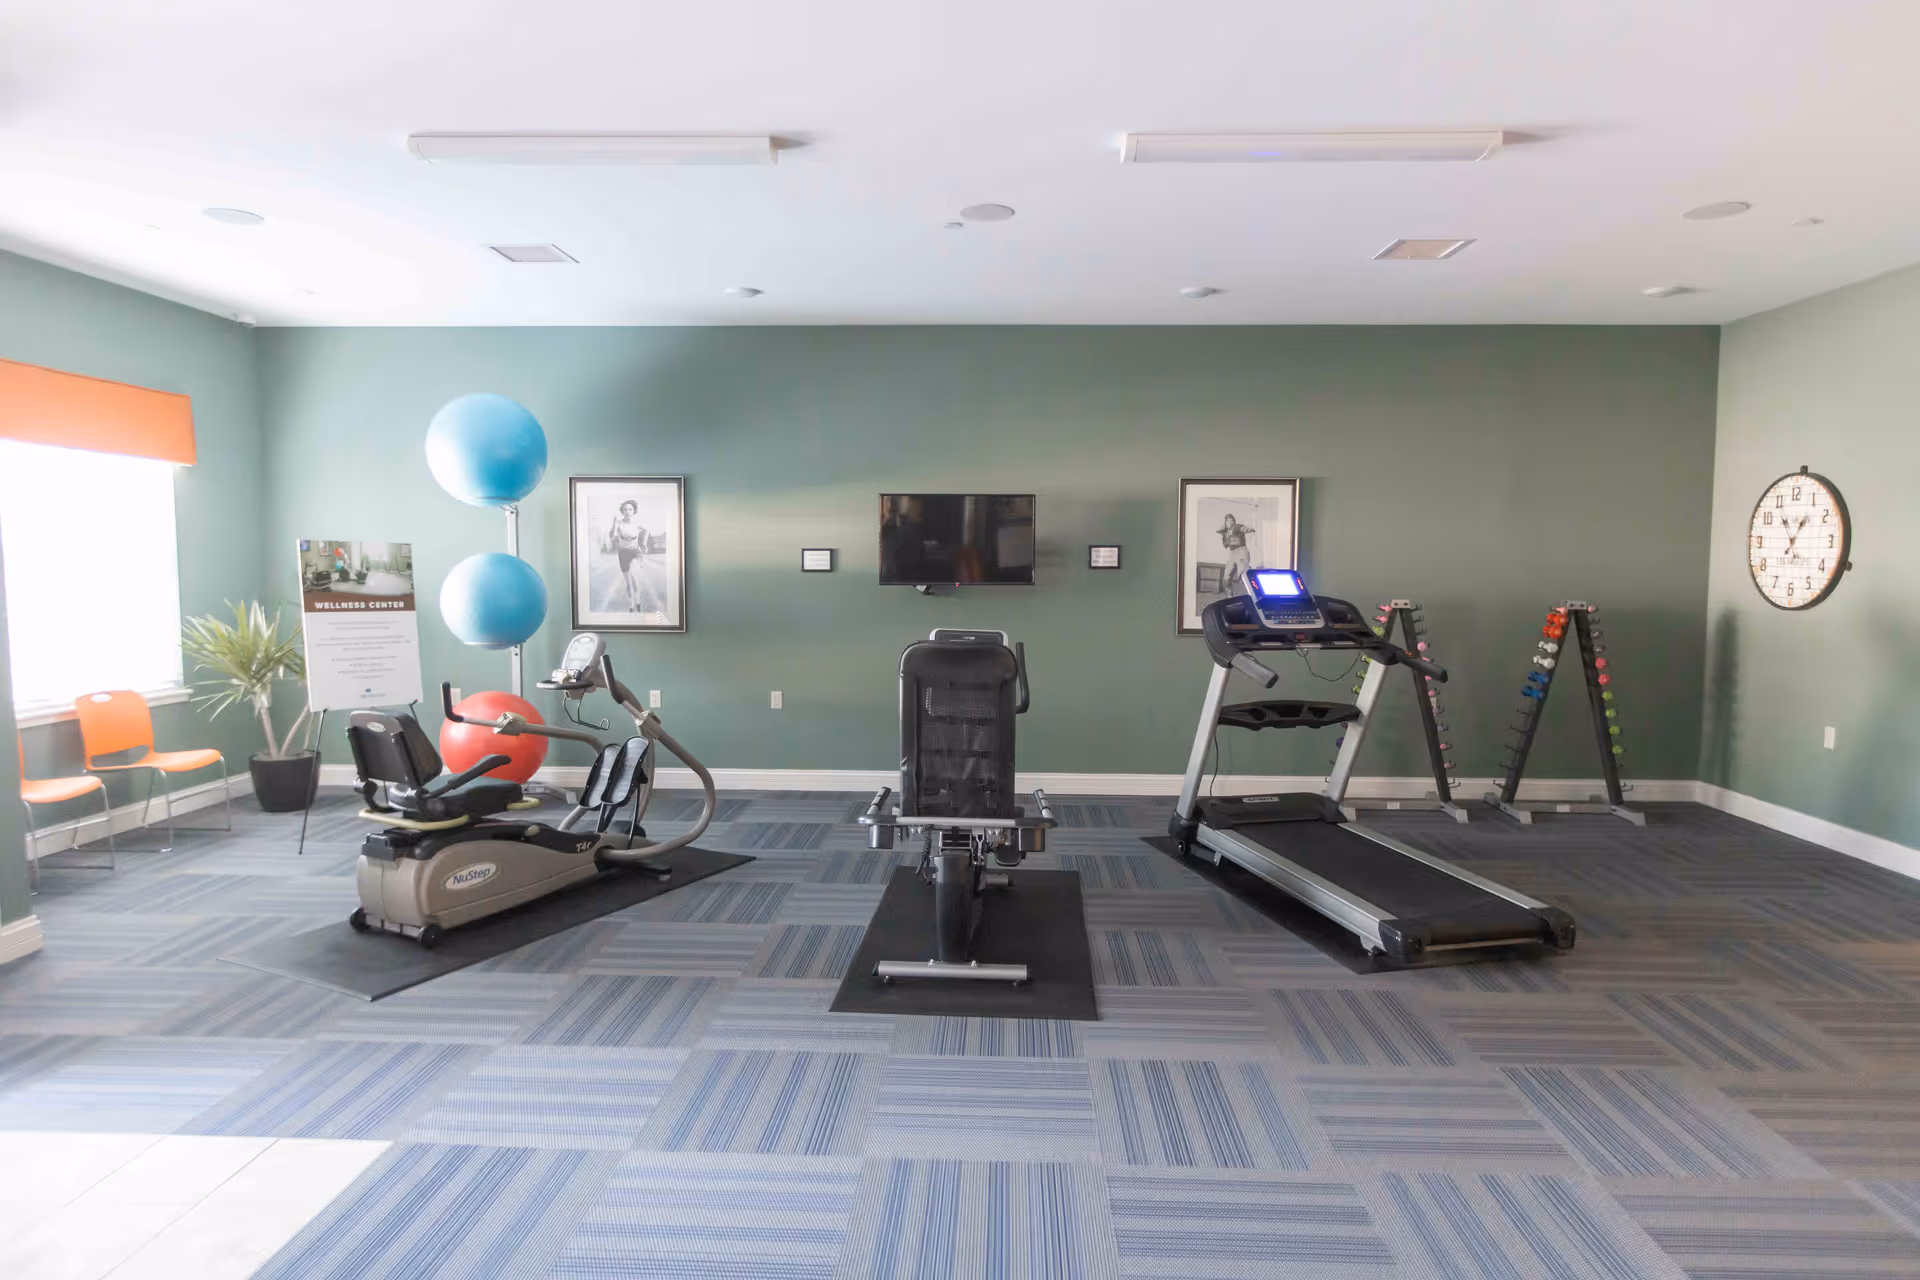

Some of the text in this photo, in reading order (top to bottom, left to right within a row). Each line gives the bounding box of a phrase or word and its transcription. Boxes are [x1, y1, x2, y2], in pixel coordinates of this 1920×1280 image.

[1792, 487, 1801, 501] 12
[1776, 495, 1783, 509] 11
[1763, 511, 1773, 525] 10
[1823, 509, 1829, 524] 2
[1757, 535, 1763, 549] 9
[1828, 534, 1834, 549] 3
[1760, 558, 1767, 572] 8
[1819, 558, 1825, 573] 4
[1772, 576, 1779, 589] 7
[1787, 582, 1794, 597] 6
[1806, 576, 1812, 590] 5
[314, 601, 405, 610] WELLNESS CENTER
[452, 867, 491, 885] NuStep
